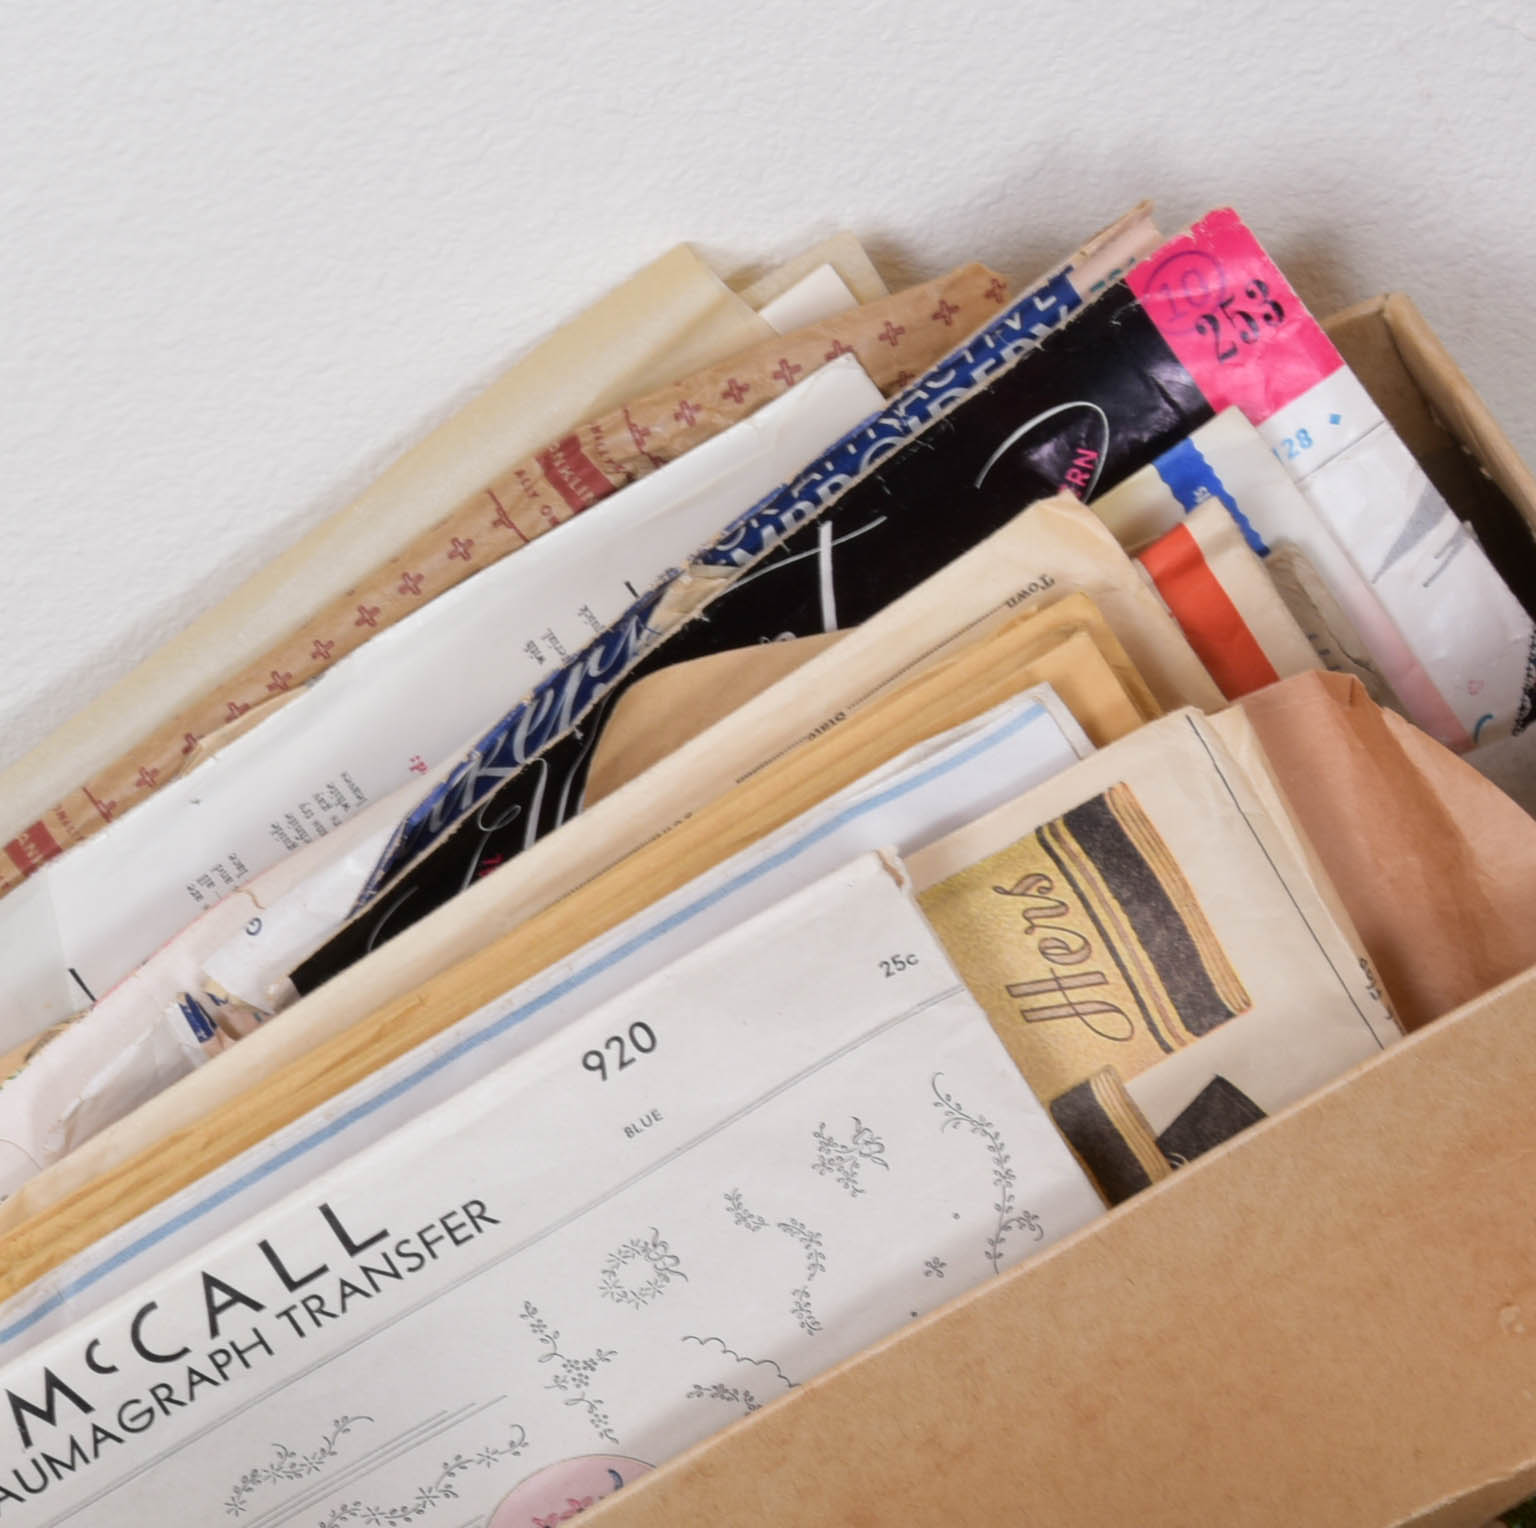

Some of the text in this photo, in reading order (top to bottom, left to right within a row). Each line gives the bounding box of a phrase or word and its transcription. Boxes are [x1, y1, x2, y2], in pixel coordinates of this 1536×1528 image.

[1195, 278, 1286, 363] 253
[993, 872, 1135, 1043] Hers
[581, 1021, 659, 1082] 920
[623, 1108, 665, 1140] BLUE
[276, 1198, 501, 1339] TRANSFER
[5, 1202, 390, 1449] McCALL
